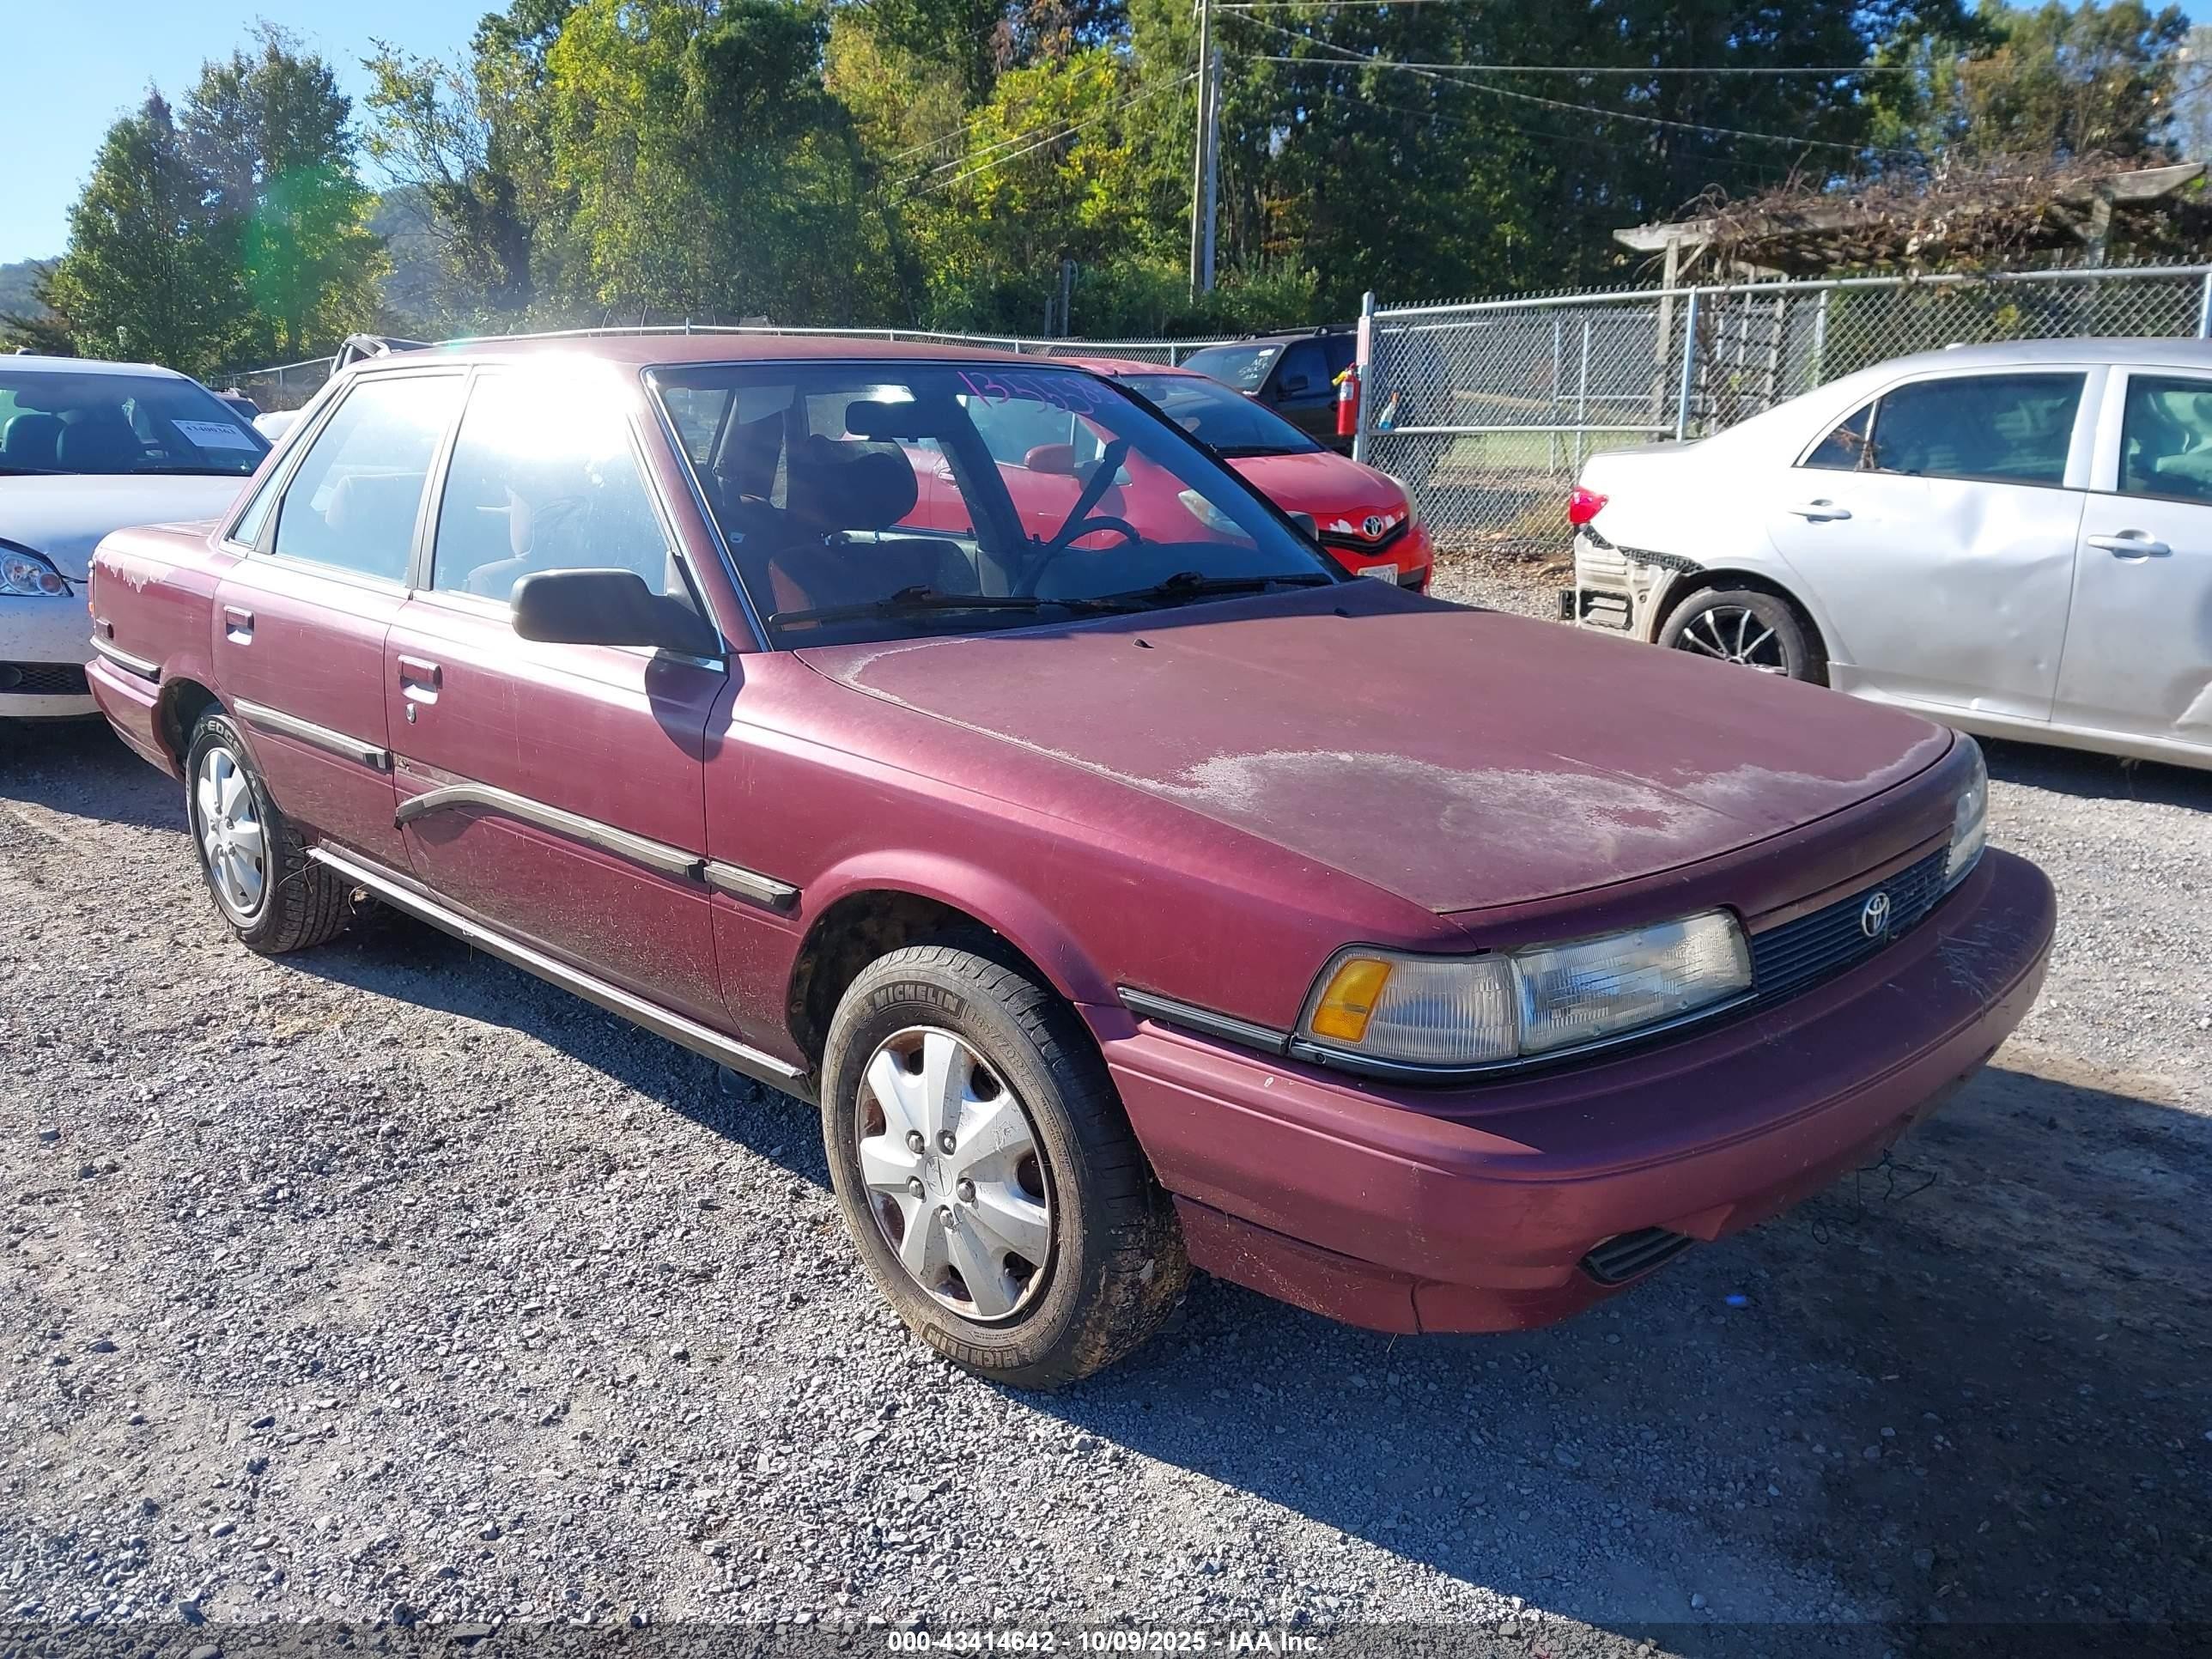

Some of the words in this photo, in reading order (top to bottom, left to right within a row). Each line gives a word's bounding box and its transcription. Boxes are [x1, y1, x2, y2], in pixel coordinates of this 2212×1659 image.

[207, 720, 244, 757] EDGE
[873, 984, 961, 1012] MICHELIN
[927, 1329, 1021, 1368] MICHELIN
